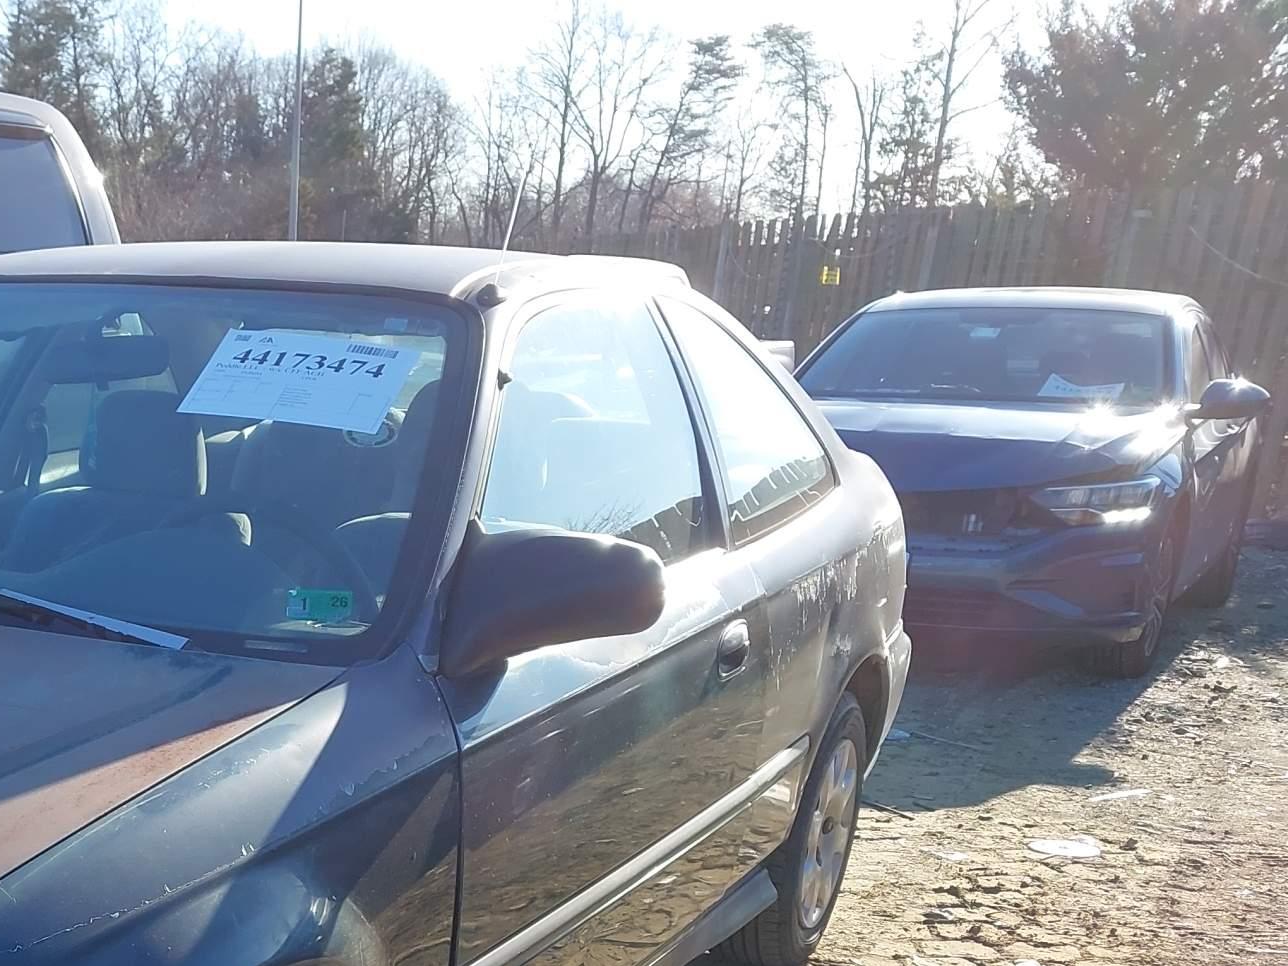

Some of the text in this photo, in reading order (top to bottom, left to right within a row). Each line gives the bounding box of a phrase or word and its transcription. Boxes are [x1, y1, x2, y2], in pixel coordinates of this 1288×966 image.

[232, 348, 386, 379] 44173474
[300, 597, 308, 611] 1
[331, 596, 349, 608] 26
